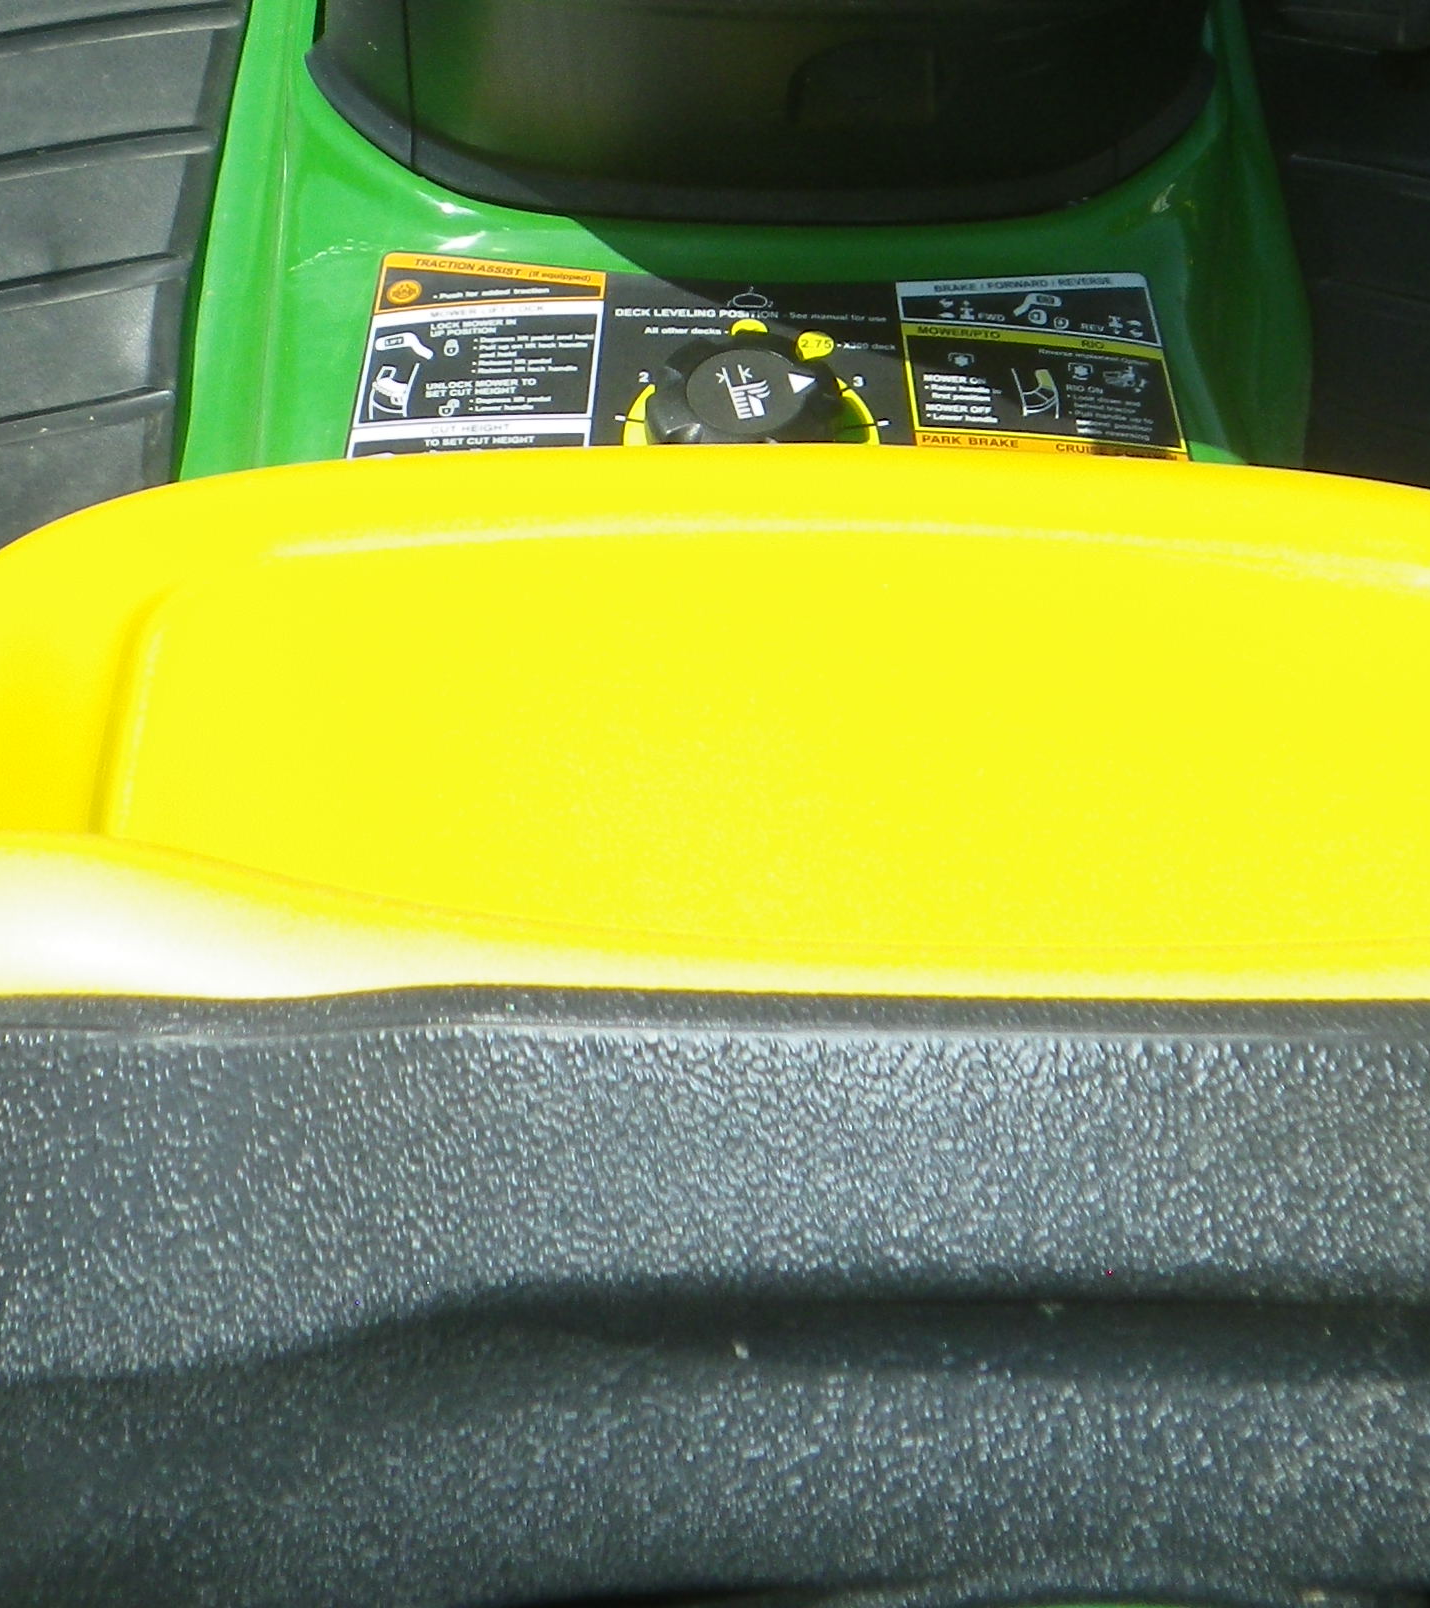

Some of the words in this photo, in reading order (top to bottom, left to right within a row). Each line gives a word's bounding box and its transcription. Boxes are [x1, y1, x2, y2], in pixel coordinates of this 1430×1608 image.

[415, 258, 475, 271] TRACTION
[477, 265, 521, 277] ASSIST
[614, 308, 651, 318] DECK
[654, 308, 717, 318] LEVELING
[718, 309, 779, 319] POSITION
[977, 311, 1006, 323] FWD
[447, 327, 497, 336] POSITION
[917, 326, 1001, 339] MOWER/PTO
[1080, 323, 1105, 333] REV
[800, 338, 832, 349] 2.75
[521, 377, 537, 386] TO
[638, 371, 649, 383] 2
[853, 375, 864, 388] 3
[449, 388, 473, 397] CUT
[424, 438, 440, 447] TO
[442, 437, 465, 446] SET
[466, 436, 490, 445] CUT
[492, 435, 536, 445] HEIGHT
[921, 434, 962, 445] PARK
[968, 436, 1019, 449] BRAKE
